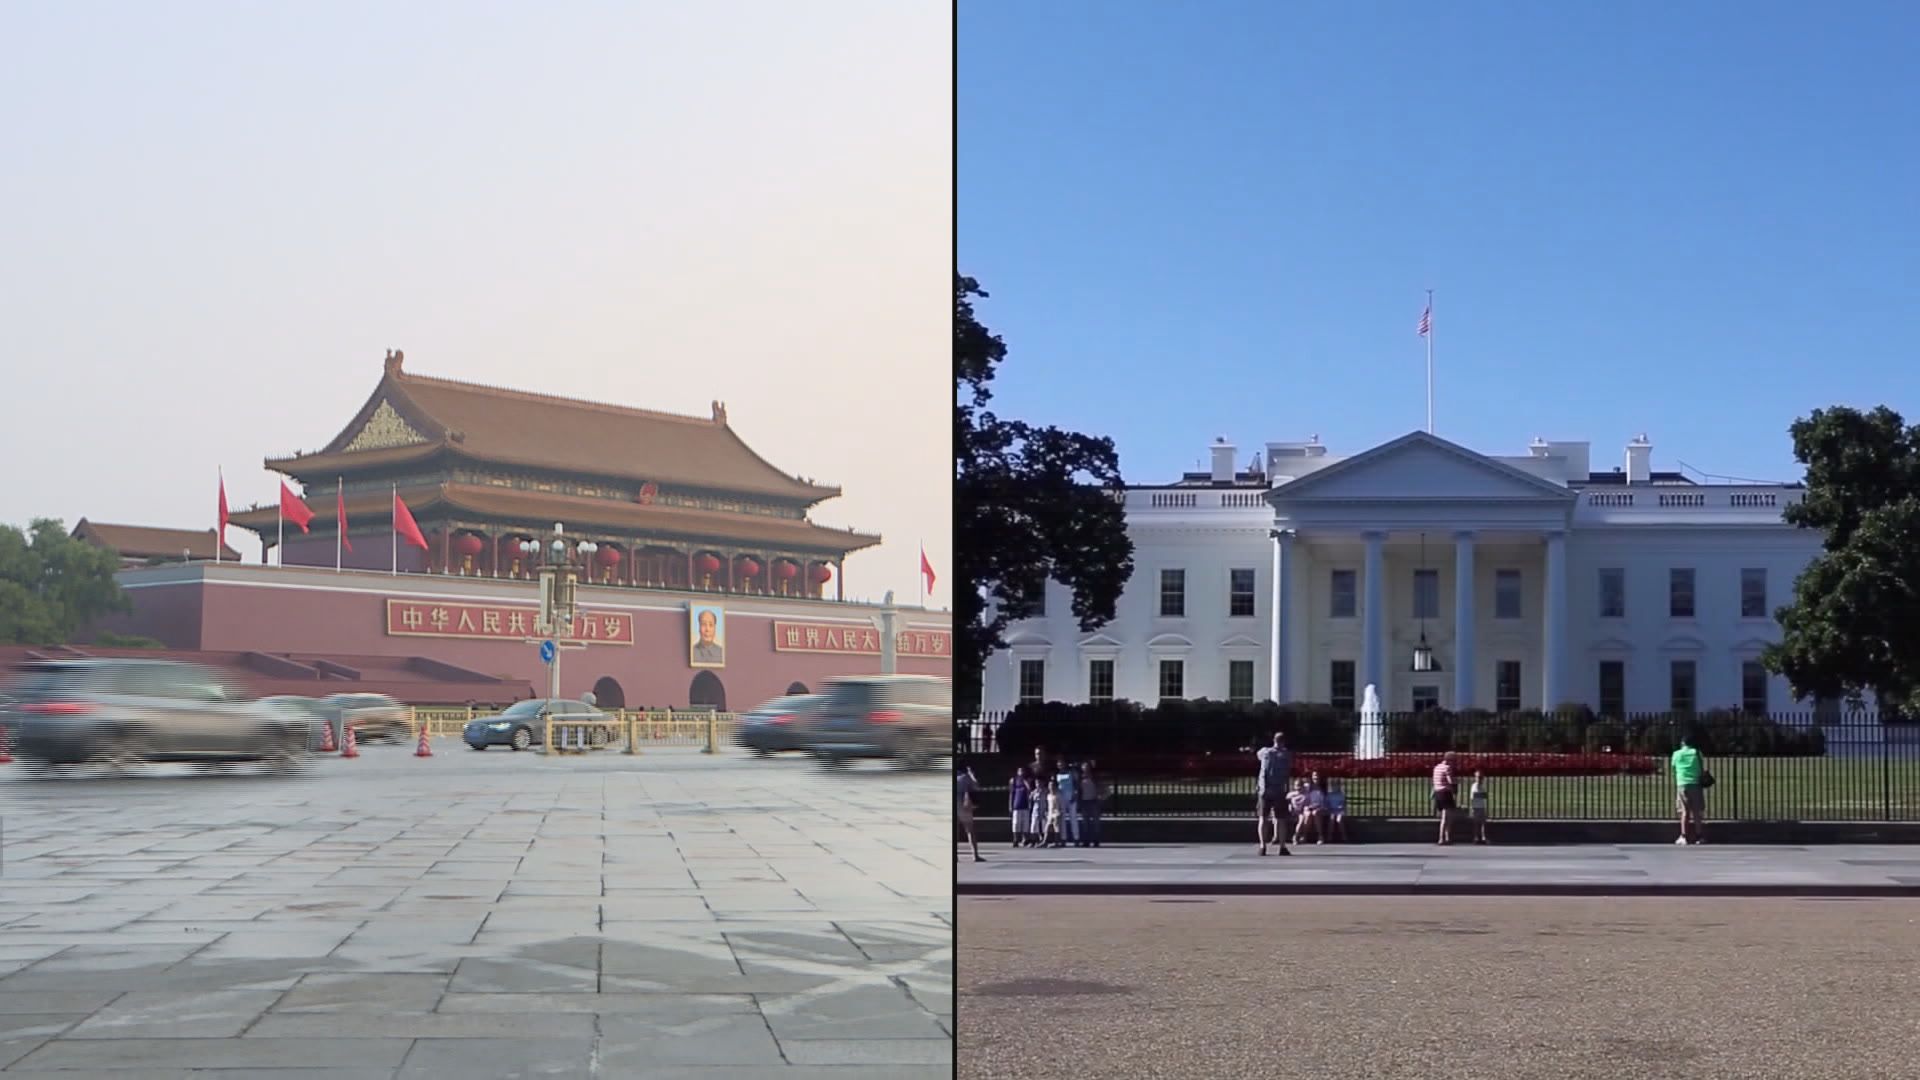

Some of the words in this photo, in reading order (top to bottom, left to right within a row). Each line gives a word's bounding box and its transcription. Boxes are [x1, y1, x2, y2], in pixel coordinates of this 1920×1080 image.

[402, 607, 620, 638] 中华人民共万岁
[786, 626, 943, 653] 世界人民大结万岁
